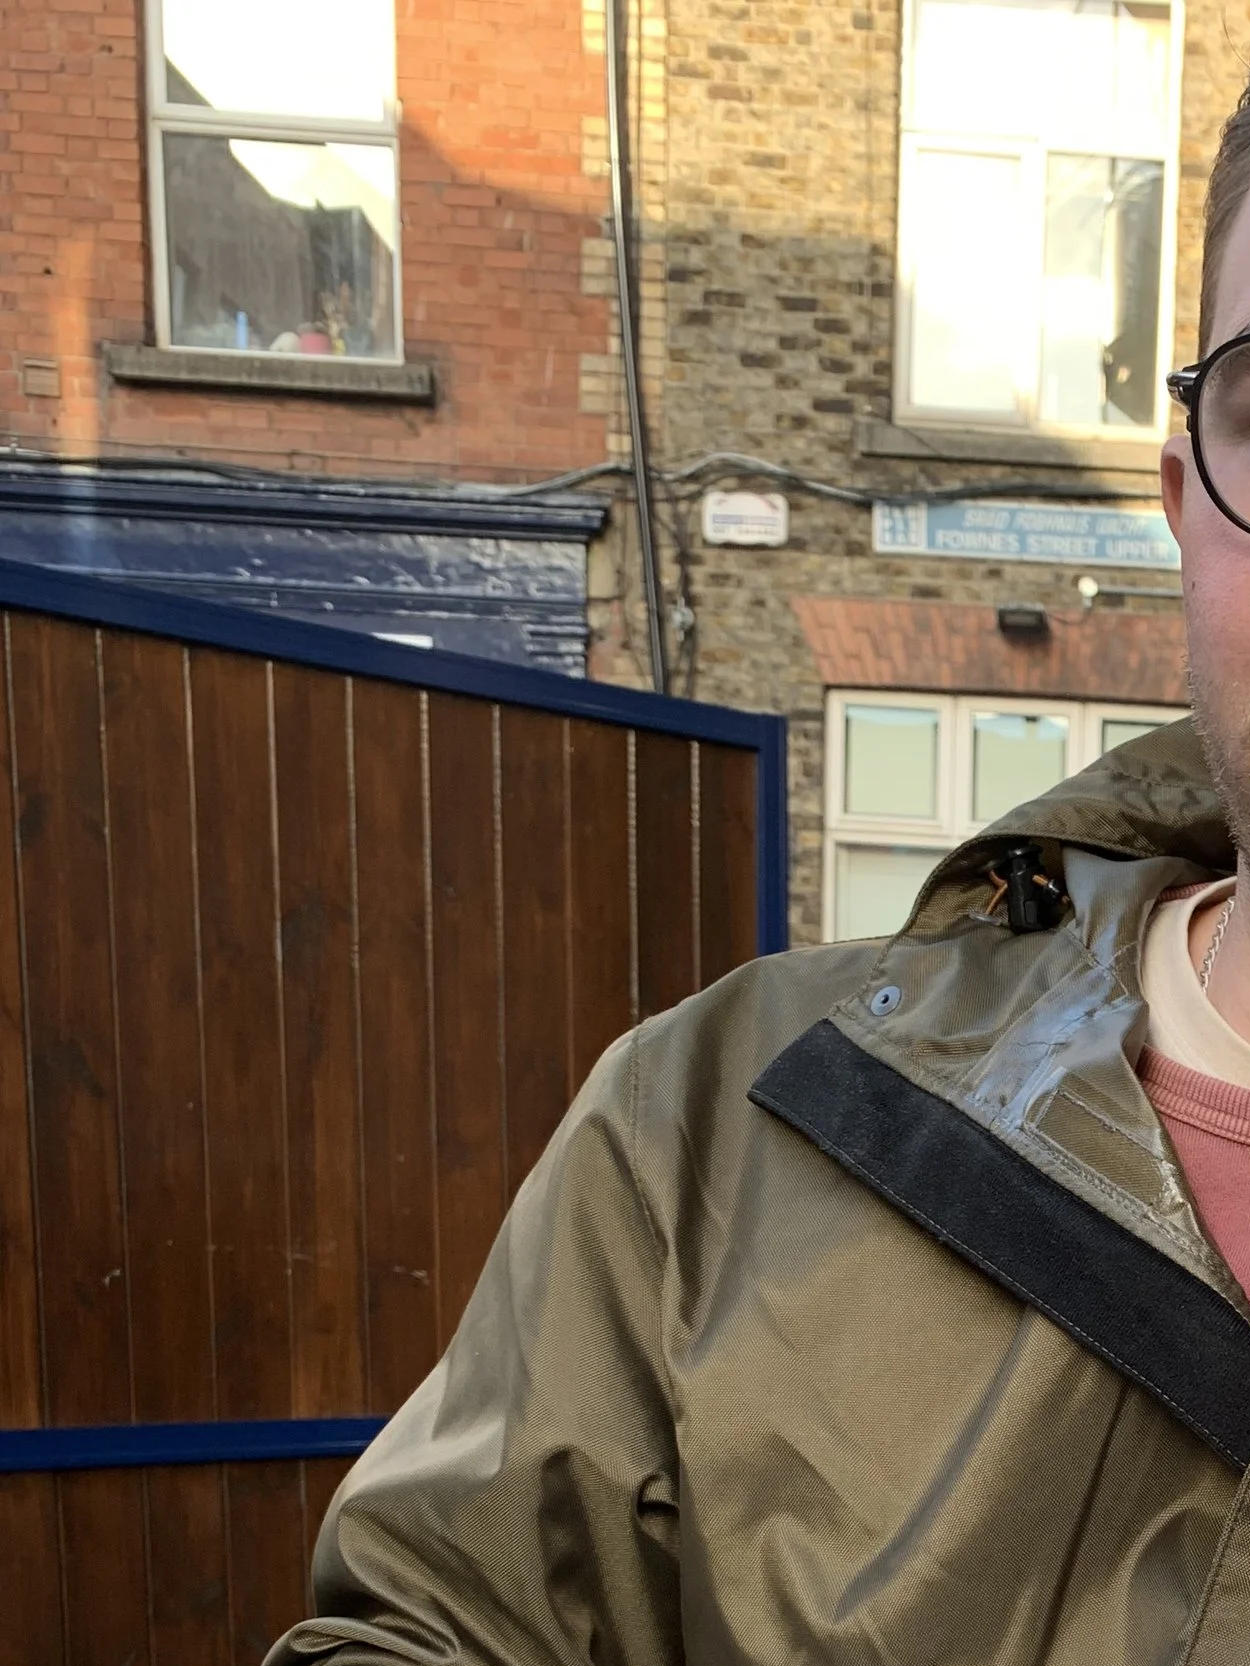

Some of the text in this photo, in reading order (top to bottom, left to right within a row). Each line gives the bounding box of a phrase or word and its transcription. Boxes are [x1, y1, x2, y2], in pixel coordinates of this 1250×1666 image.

[935, 529, 1169, 560] FOWNES STREET UPPER
